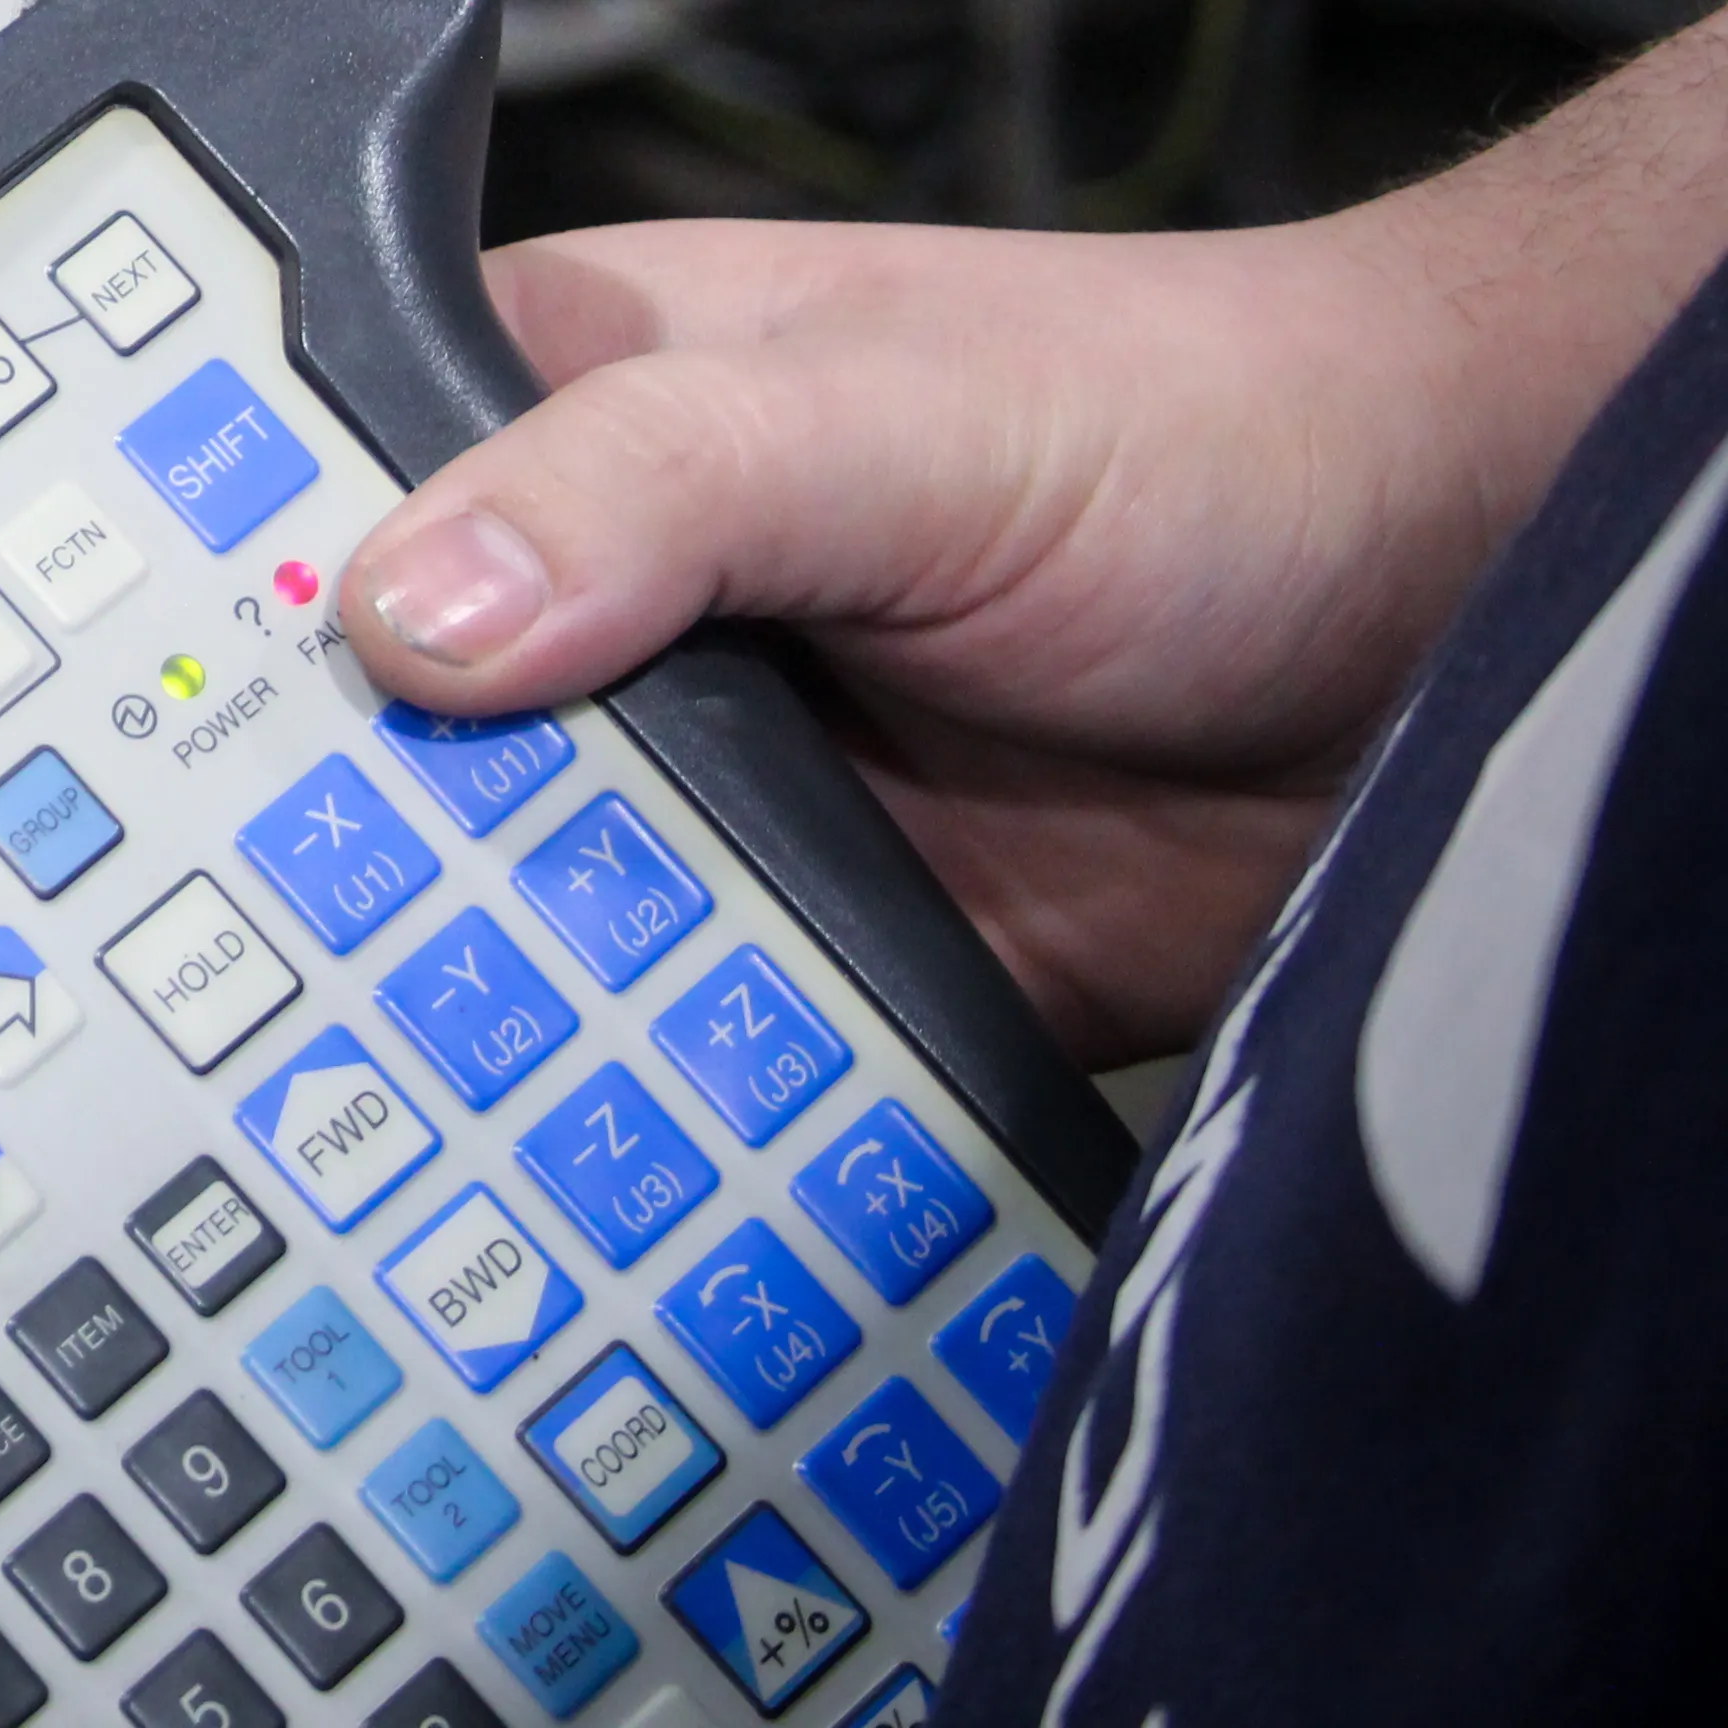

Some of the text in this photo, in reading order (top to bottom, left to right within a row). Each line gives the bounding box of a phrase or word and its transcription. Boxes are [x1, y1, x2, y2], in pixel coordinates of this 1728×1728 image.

[90, 250, 158, 311] NEXT
[168, 405, 269, 500] SHIFT
[35, 521, 107, 583] FCTN
[173, 678, 278, 769] POWER
[471, 734, 540, 802] (J1)
[9, 787, 80, 855] GROUP
[293, 793, 361, 855] -X
[334, 852, 404, 920] (J1)
[568, 829, 626, 895] +Y
[610, 888, 678, 956] (J2)
[153, 930, 246, 1013] HOLD
[432, 946, 489, 1010] -Y
[473, 1007, 542, 1075] (J2)
[707, 983, 774, 1051] +Z
[748, 1043, 819, 1110] (J3)
[297, 1090, 390, 1175] FWD
[574, 1106, 639, 1168] -Z
[613, 1164, 684, 1233] (J3)
[867, 1159, 923, 1218] +X
[166, 1197, 250, 1271] ENTER
[889, 1203, 959, 1269] (J4)
[428, 1237, 522, 1327] BWD
[733, 1282, 789, 1337] -X
[55, 1305, 124, 1368] ITEM
[275, 1320, 350, 1384] TOOL
[755, 1323, 826, 1390] (J4)
[326, 1369, 347, 1390] 1
[182, 1445, 229, 1497] 9
[580, 1403, 667, 1489] COORD
[874, 1440, 925, 1495] -Y
[393, 1455, 467, 1518] TOOL
[444, 1502, 468, 1527] 2
[897, 1479, 968, 1549] (J5)
[62, 1550, 112, 1603] 8
[302, 1578, 348, 1631] 6
[509, 1581, 588, 1659] MOVE
[533, 1612, 611, 1685] MENU
[760, 1597, 830, 1668] +%
[179, 1682, 230, 1728] 5
